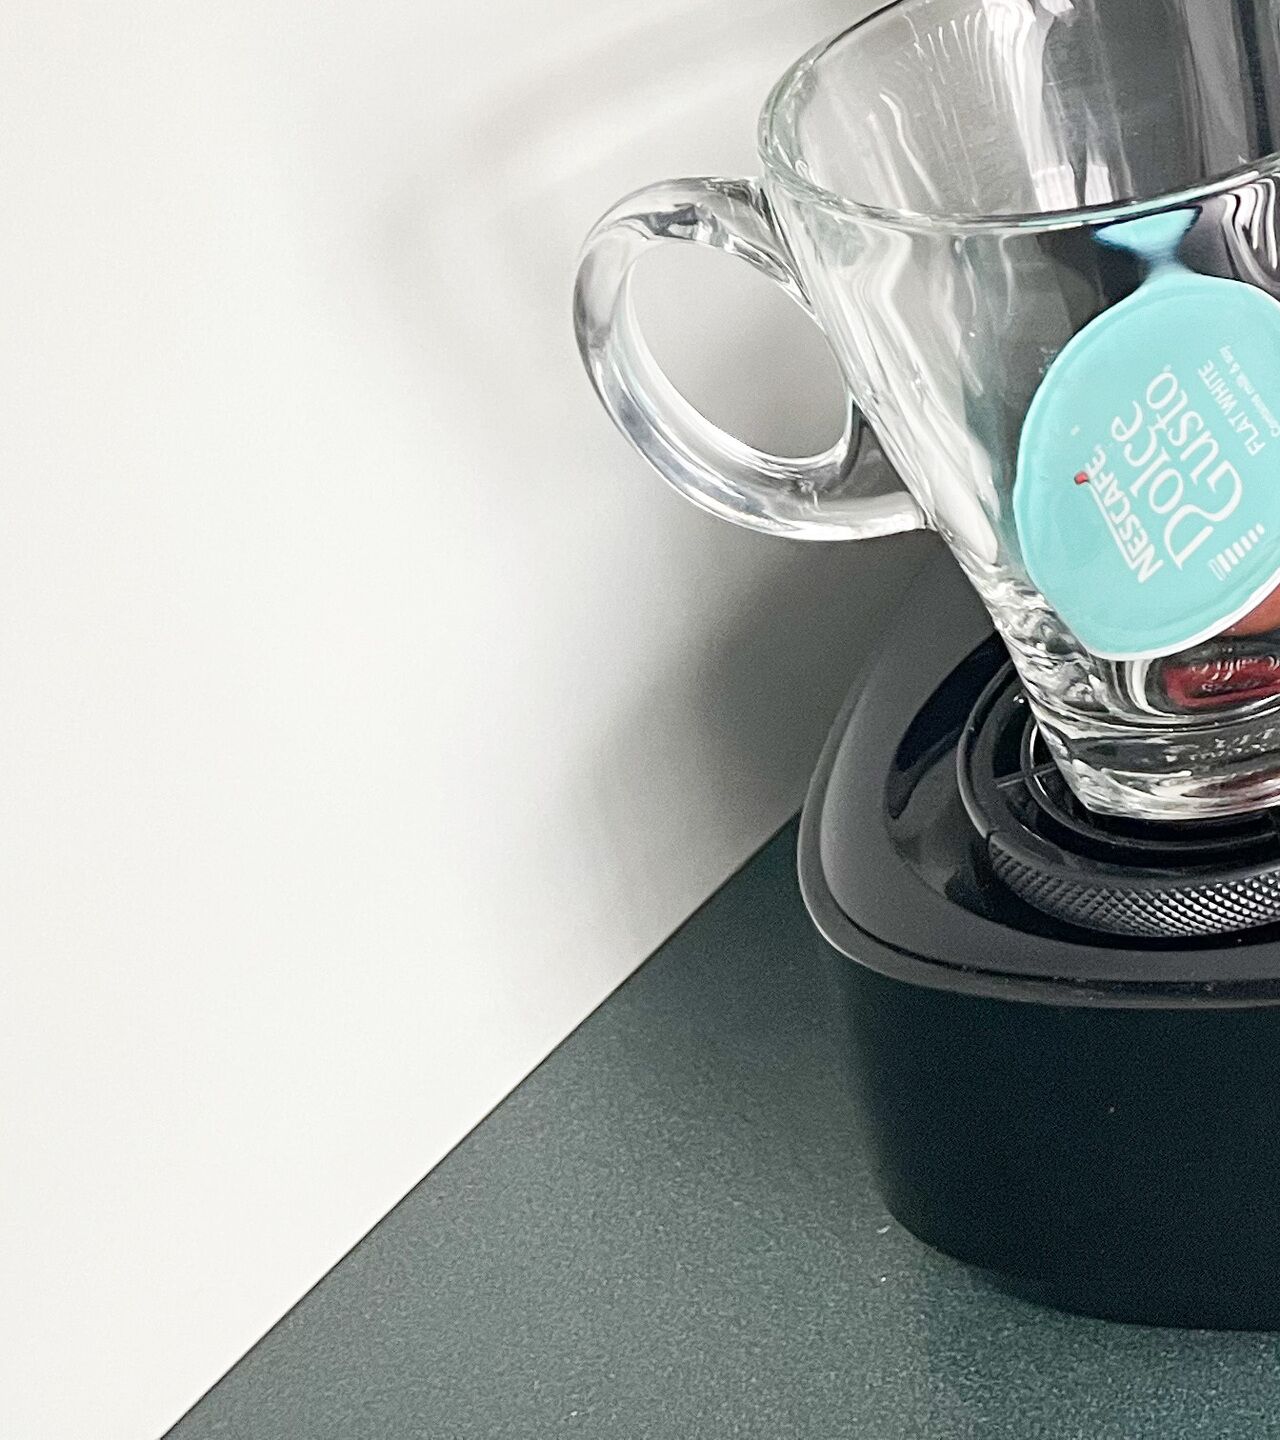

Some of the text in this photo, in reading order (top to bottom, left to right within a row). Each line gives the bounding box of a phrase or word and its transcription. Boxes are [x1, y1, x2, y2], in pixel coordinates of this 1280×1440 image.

[1145, 372, 1243, 522] Gusto
[1197, 359, 1266, 456] FLAT WHITE
[1110, 399, 1214, 571] Dolce
